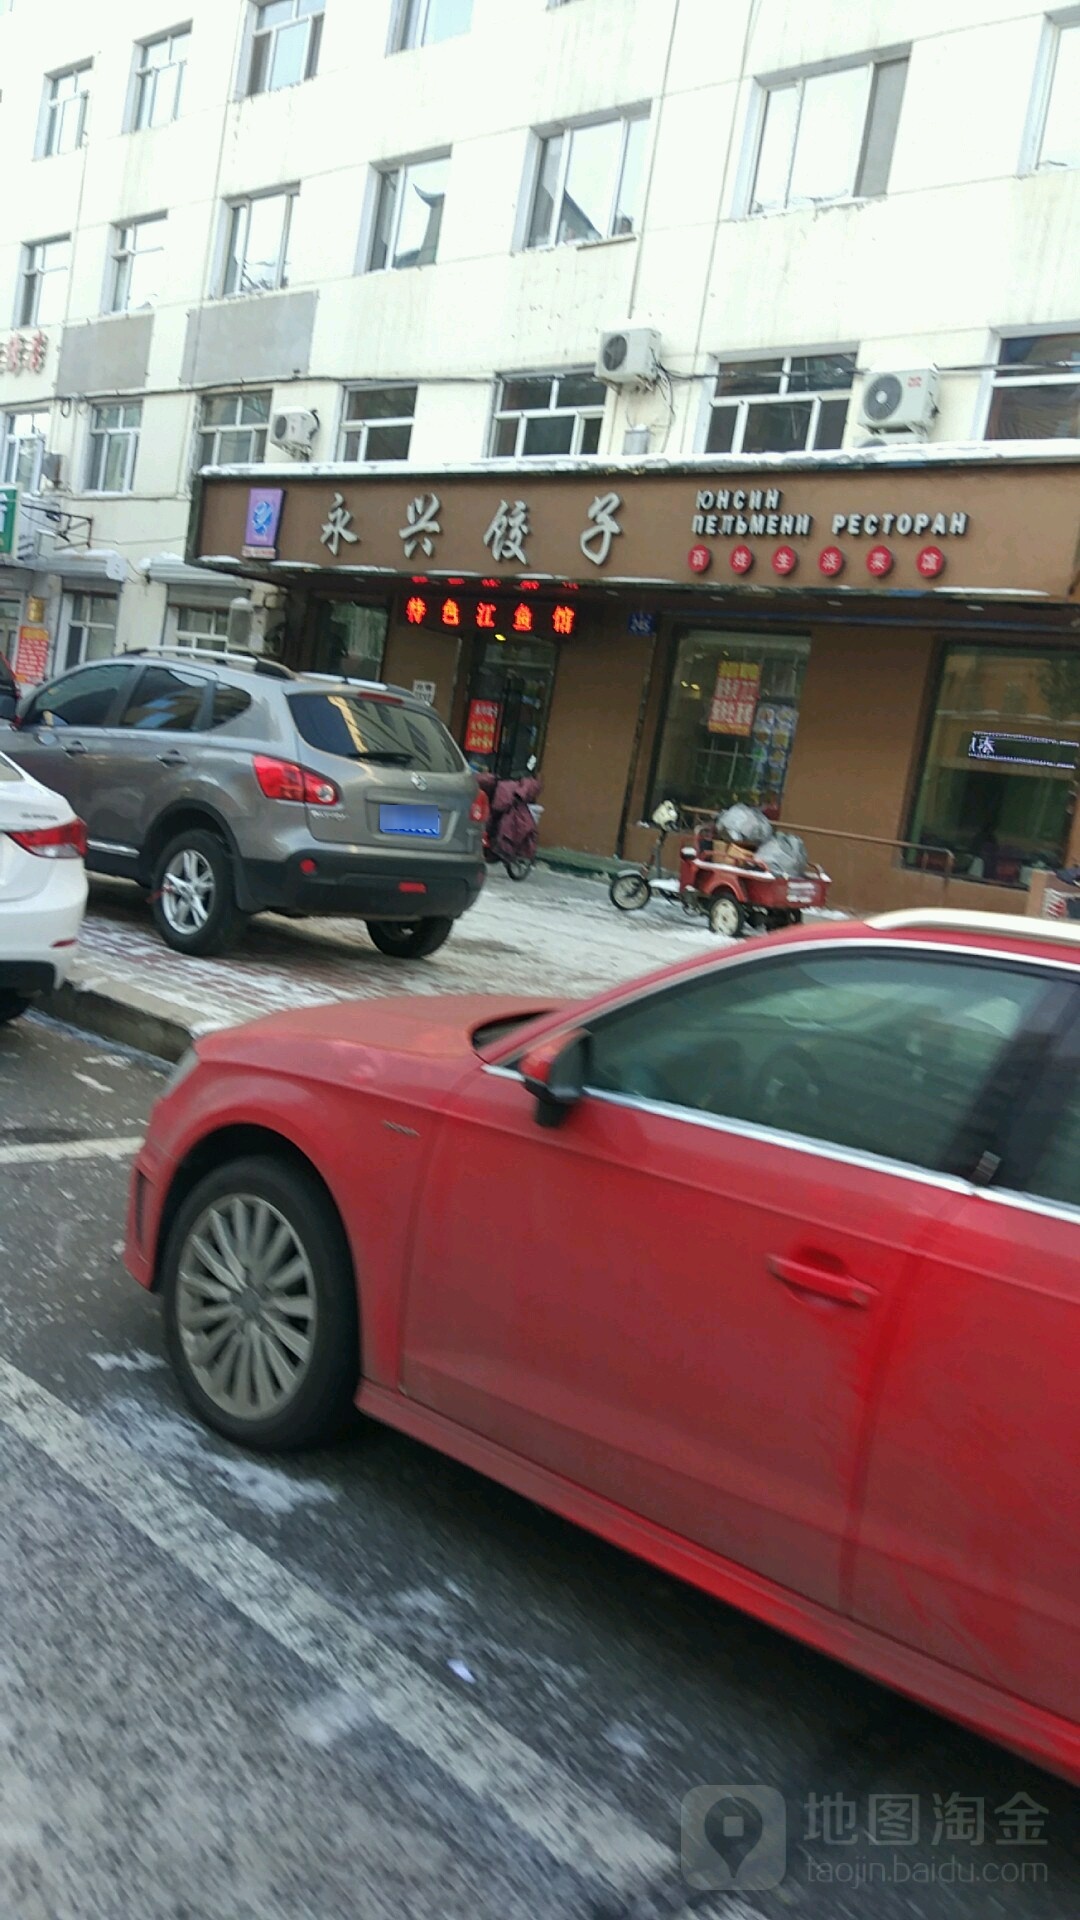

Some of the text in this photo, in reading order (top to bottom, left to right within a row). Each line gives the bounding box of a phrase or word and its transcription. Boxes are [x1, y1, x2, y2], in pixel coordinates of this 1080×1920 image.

[695, 487, 783, 511] ЮНСИН
[320, 491, 623, 566] 永兴饺子
[691, 512, 969, 536] ПЕЛЬМЕНИ РЕСТОРАН
[405, 597, 576, 635] 特色江鱼馆
